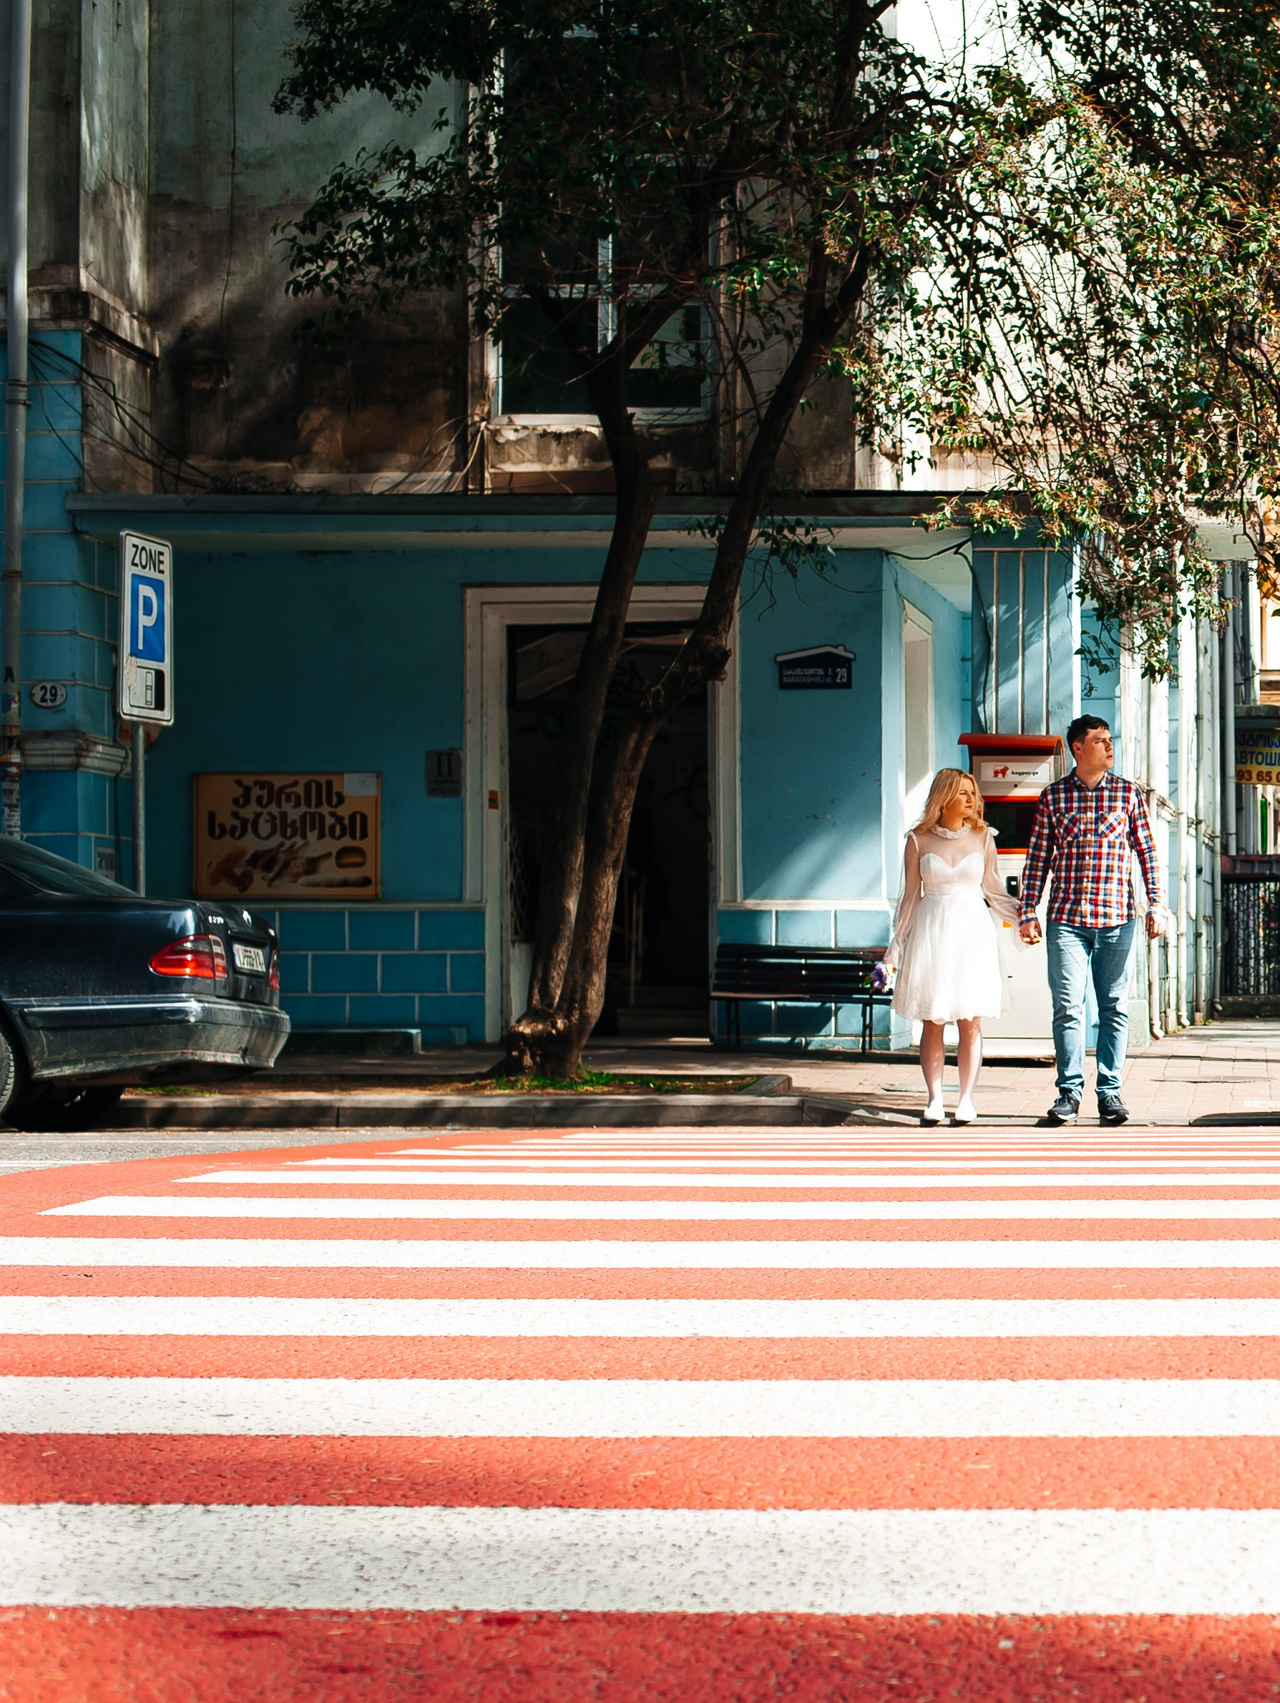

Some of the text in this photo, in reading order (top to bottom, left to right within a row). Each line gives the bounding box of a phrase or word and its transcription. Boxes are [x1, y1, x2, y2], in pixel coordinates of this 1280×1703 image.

[131, 543, 165, 575] ZONE
[138, 583, 158, 650] P
[836, 668, 847, 683] 29
[39, 685, 58, 703] 29
[1256, 770, 1273, 783] 65
[231, 779, 345, 809] პურის
[207, 811, 369, 841] საცხობი
